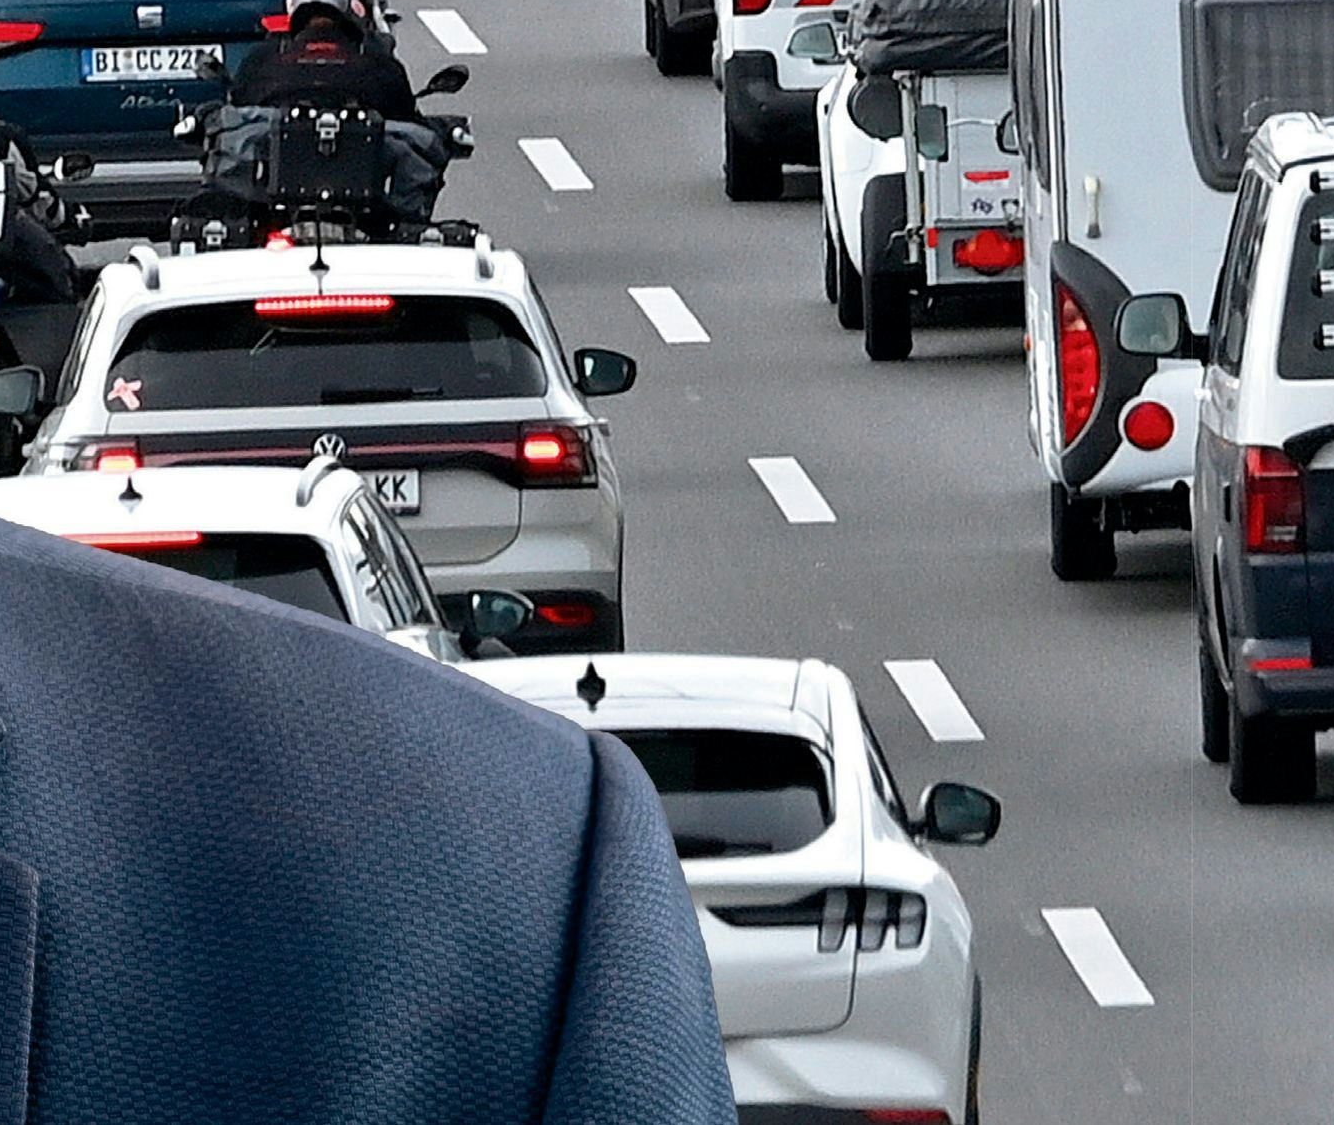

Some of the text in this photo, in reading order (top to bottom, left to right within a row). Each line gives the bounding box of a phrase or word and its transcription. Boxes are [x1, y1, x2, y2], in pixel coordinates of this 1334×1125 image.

[95, 51, 121, 73] BI
[136, 49, 163, 72] CC
[375, 474, 407, 503] KK
